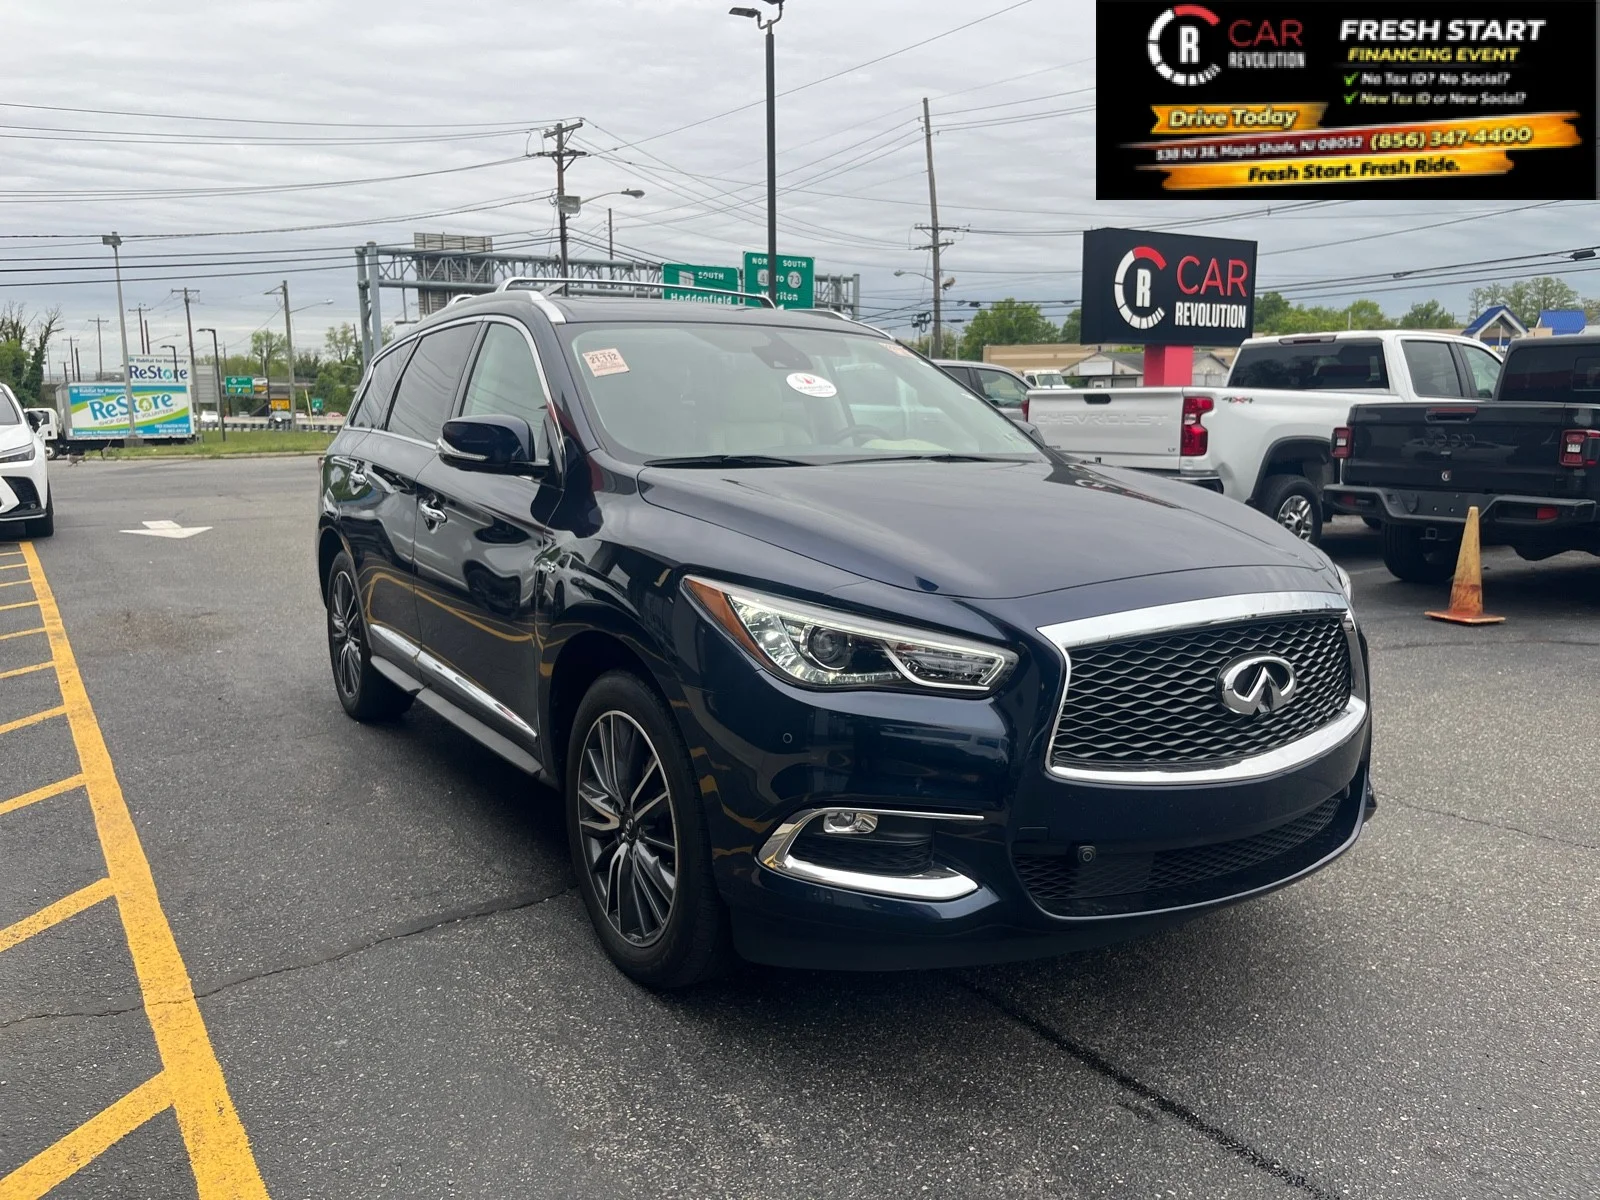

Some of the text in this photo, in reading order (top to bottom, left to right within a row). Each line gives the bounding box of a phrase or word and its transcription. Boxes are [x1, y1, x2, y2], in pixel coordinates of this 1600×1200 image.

[783, 259, 807, 268] SOUTH
[698, 271, 724, 281] SOUTH
[788, 274, 801, 287] 73
[1177, 255, 1249, 298] CAR
[1136, 268, 1152, 308] R
[670, 292, 732, 305] Haddonfield
[1175, 301, 1247, 329] REVOLUTION
[129, 365, 188, 380] ReStore
[88, 393, 173, 421] ReStore
[1036, 413, 1170, 427] CHEVROLET
